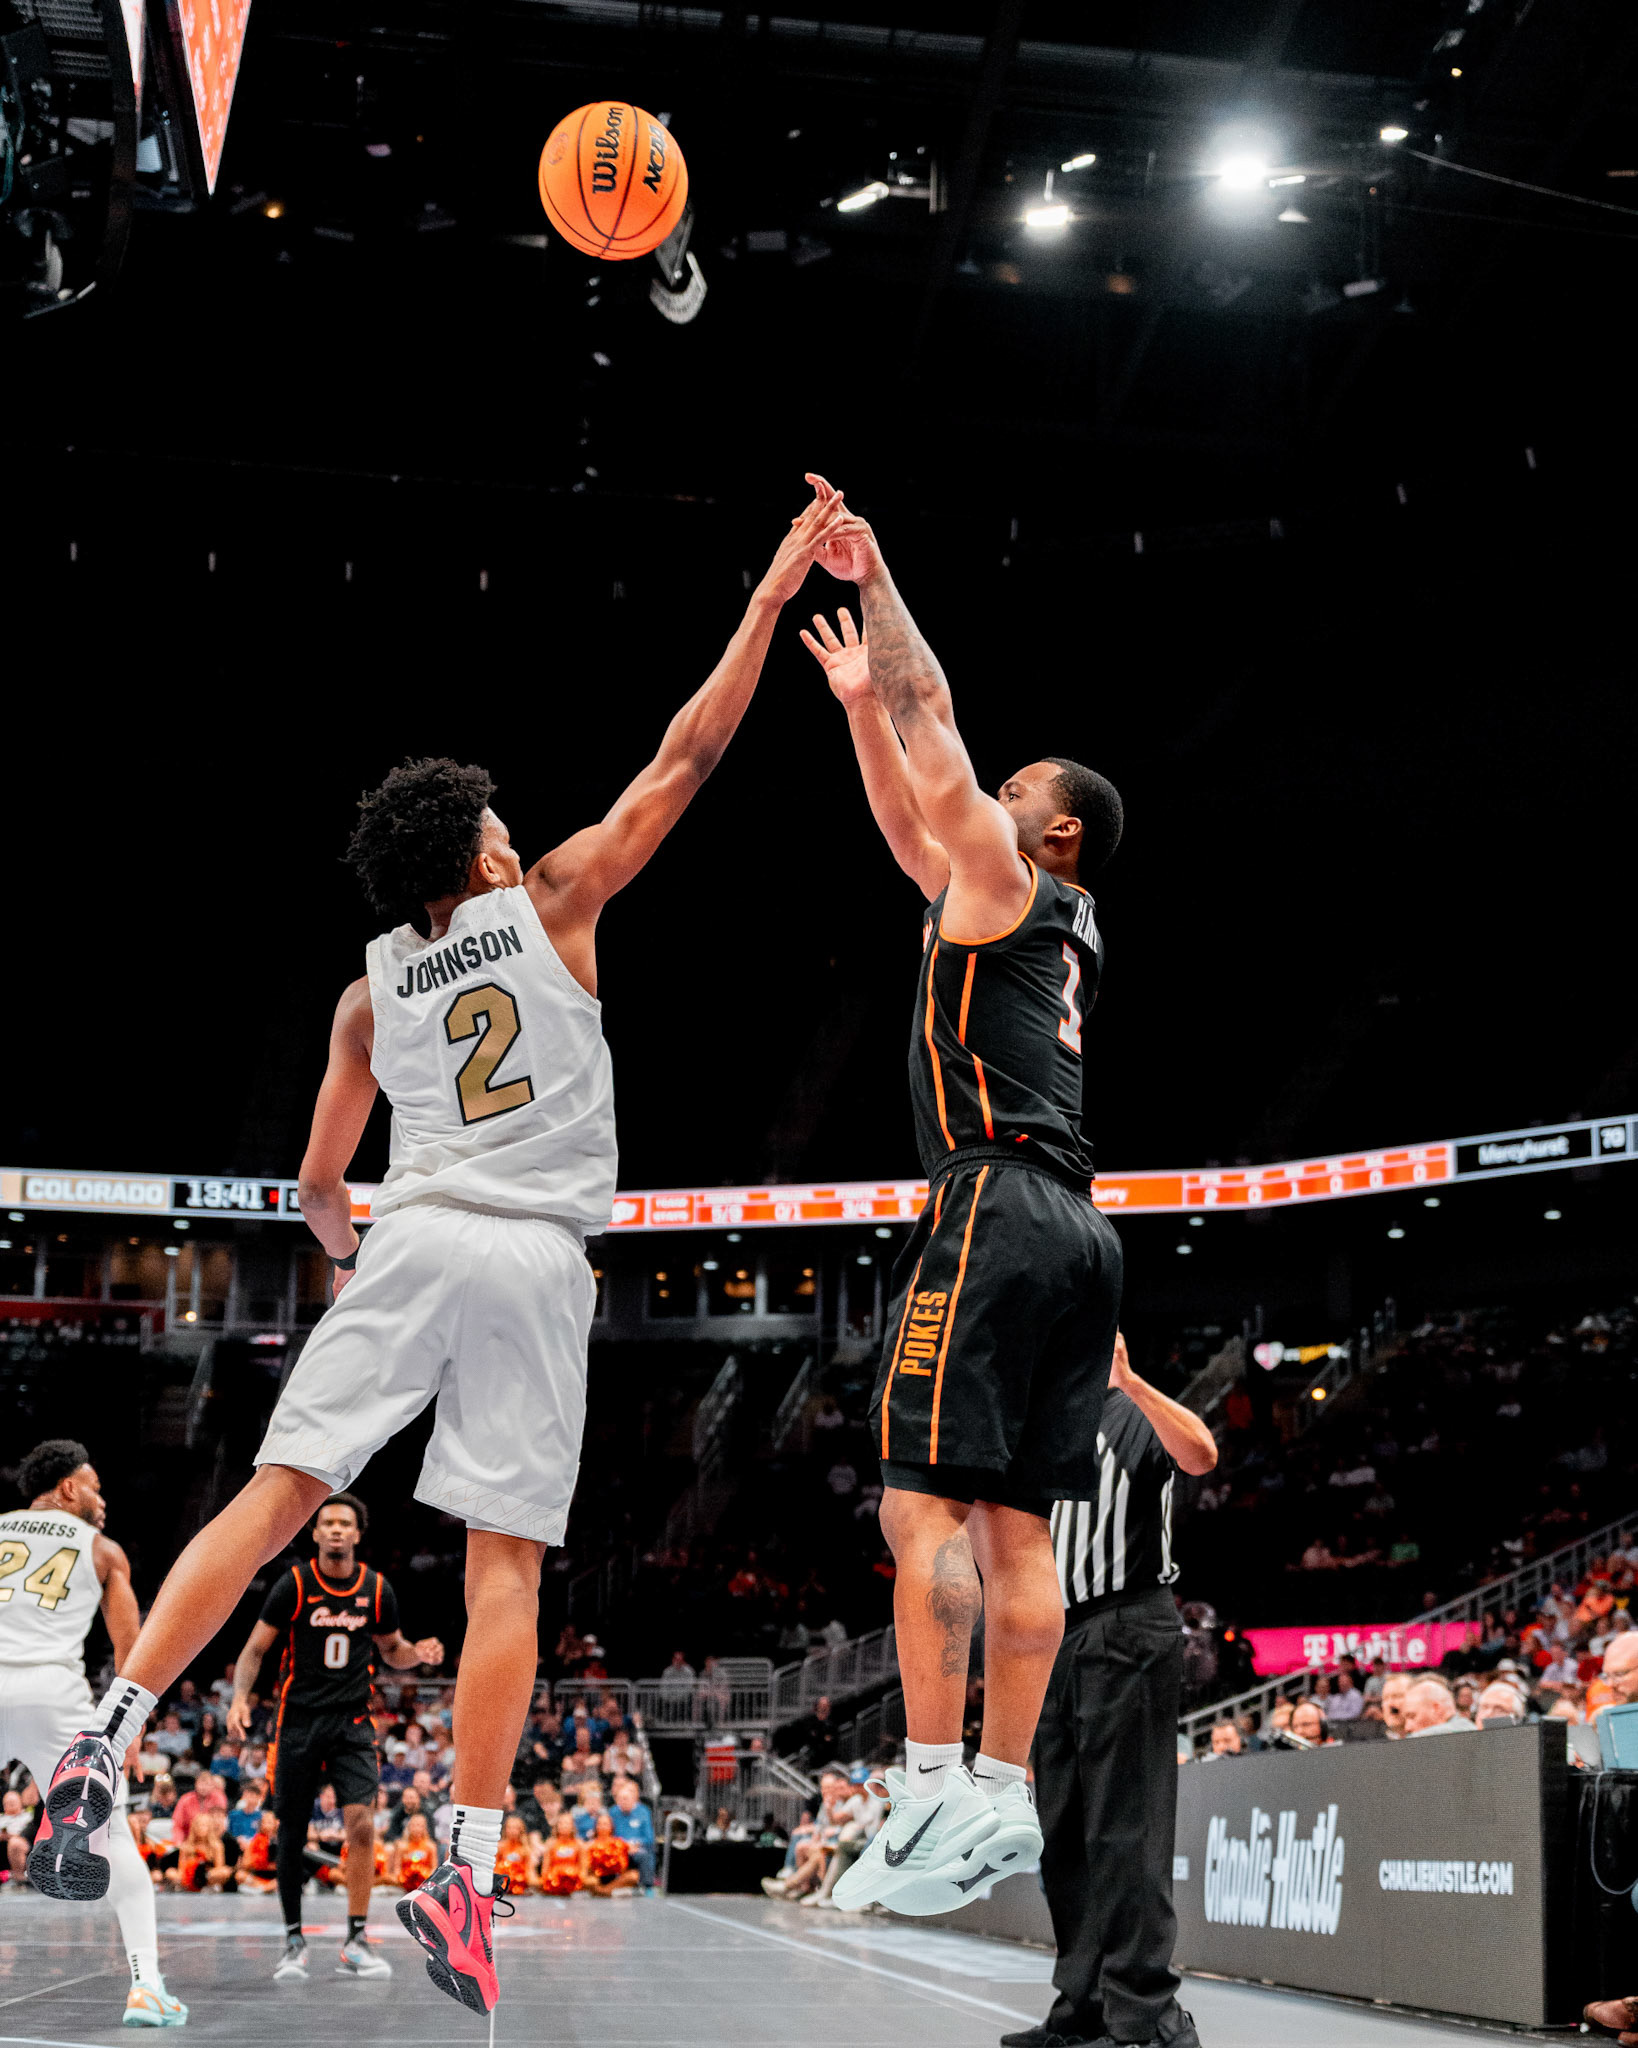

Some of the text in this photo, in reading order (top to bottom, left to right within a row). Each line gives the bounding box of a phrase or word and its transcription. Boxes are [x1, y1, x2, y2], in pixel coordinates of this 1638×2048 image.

[592, 107, 624, 194] Wilson
[397, 925, 523, 998] JOHNSON
[1058, 940, 1082, 1055] 1
[443, 982, 535, 1126] 2
[1478, 1135, 1569, 1165] Mercyhurst
[26, 1176, 166, 1206] COLORADO
[187, 1180, 265, 1210] 13:41
[1248, 1186, 1262, 1204] 0
[1290, 1180, 1300, 1199] 1
[1330, 1175, 1343, 1194] 0
[1370, 1170, 1383, 1189] 0
[1413, 1164, 1427, 1183] 0
[899, 1291, 947, 1377] POKES
[0, 1540, 80, 1611] 24
[310, 1606, 368, 1631] Cowboys
[324, 1633, 350, 1669] 0
[1204, 1803, 1345, 1936] Charlie Hustle
[1378, 1858, 1514, 1896] CHARLIEHUSTLE.COM
